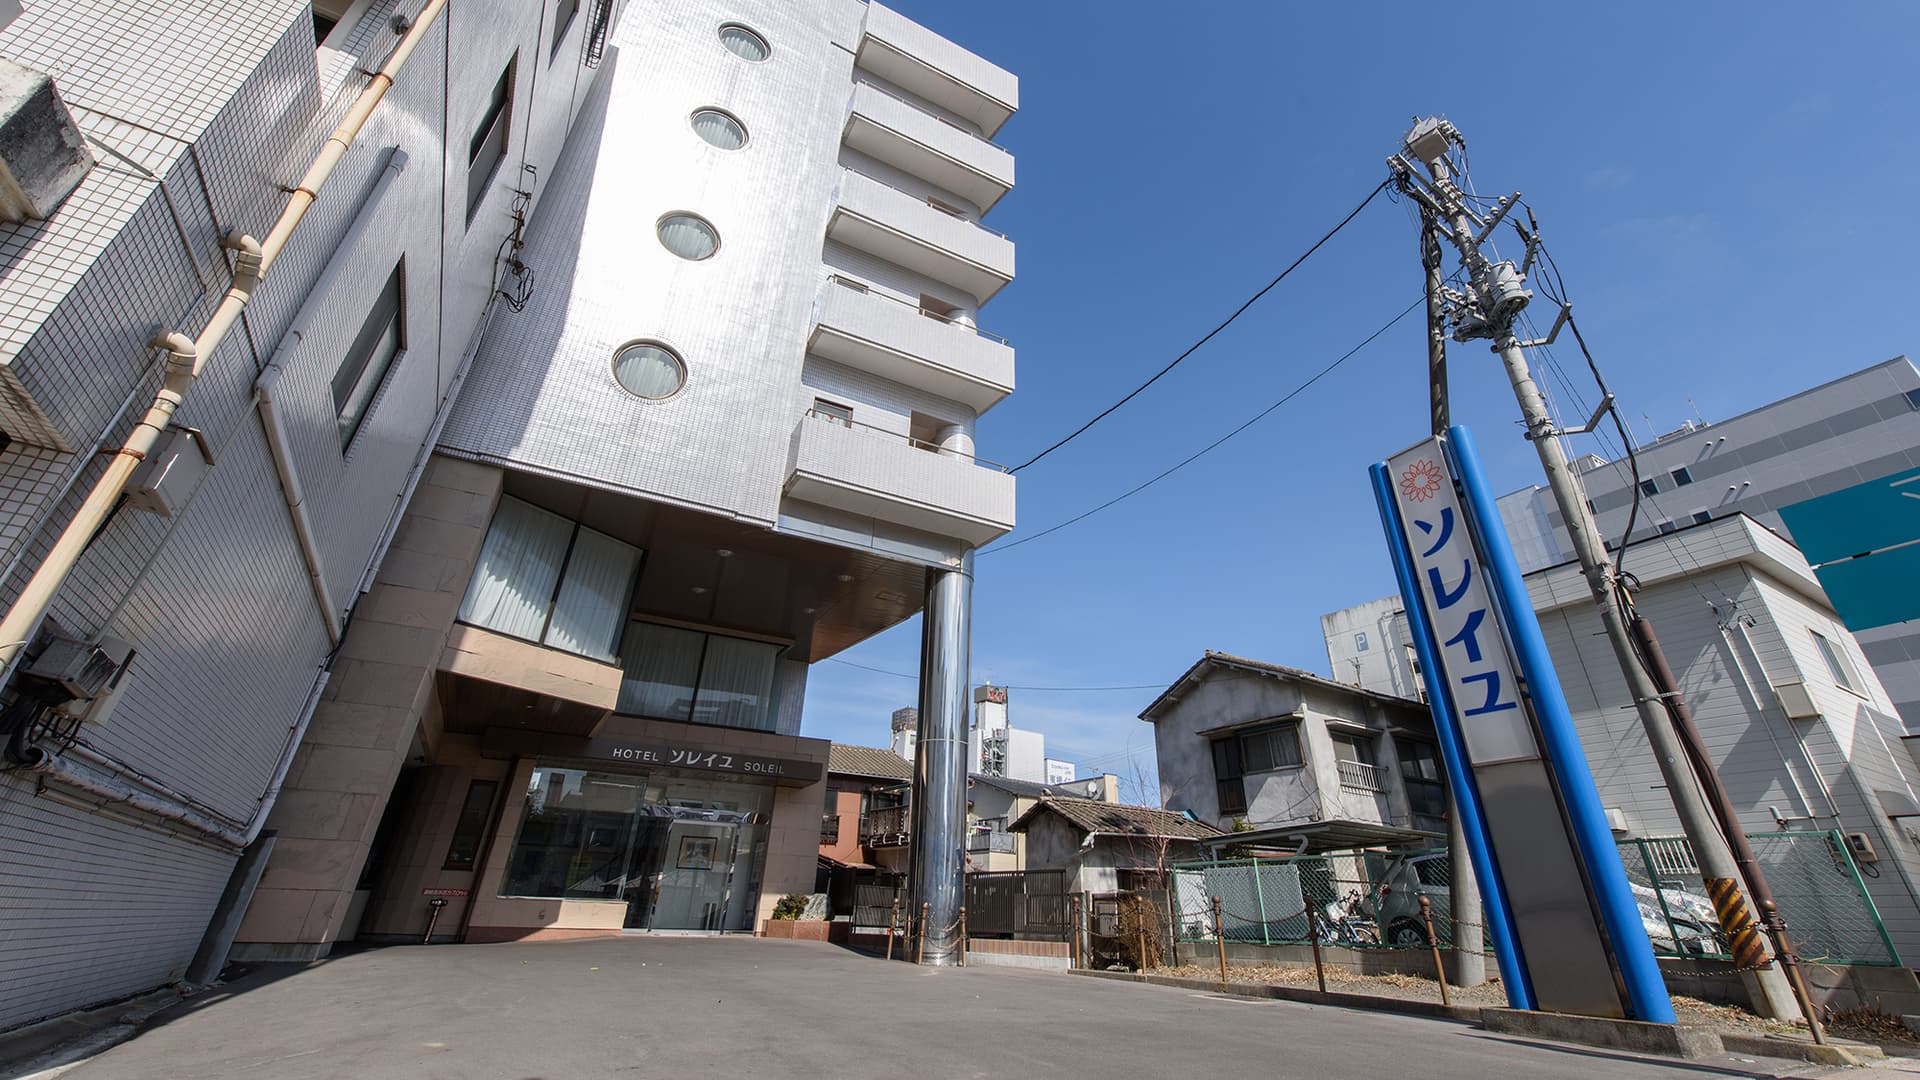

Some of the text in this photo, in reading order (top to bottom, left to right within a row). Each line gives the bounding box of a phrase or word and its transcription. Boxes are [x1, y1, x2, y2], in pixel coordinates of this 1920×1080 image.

[1414, 506, 1517, 716] ソレイユ
[1356, 635, 1366, 650] P
[612, 748, 785, 775] HOTEL ソレイユ SOLEIL
